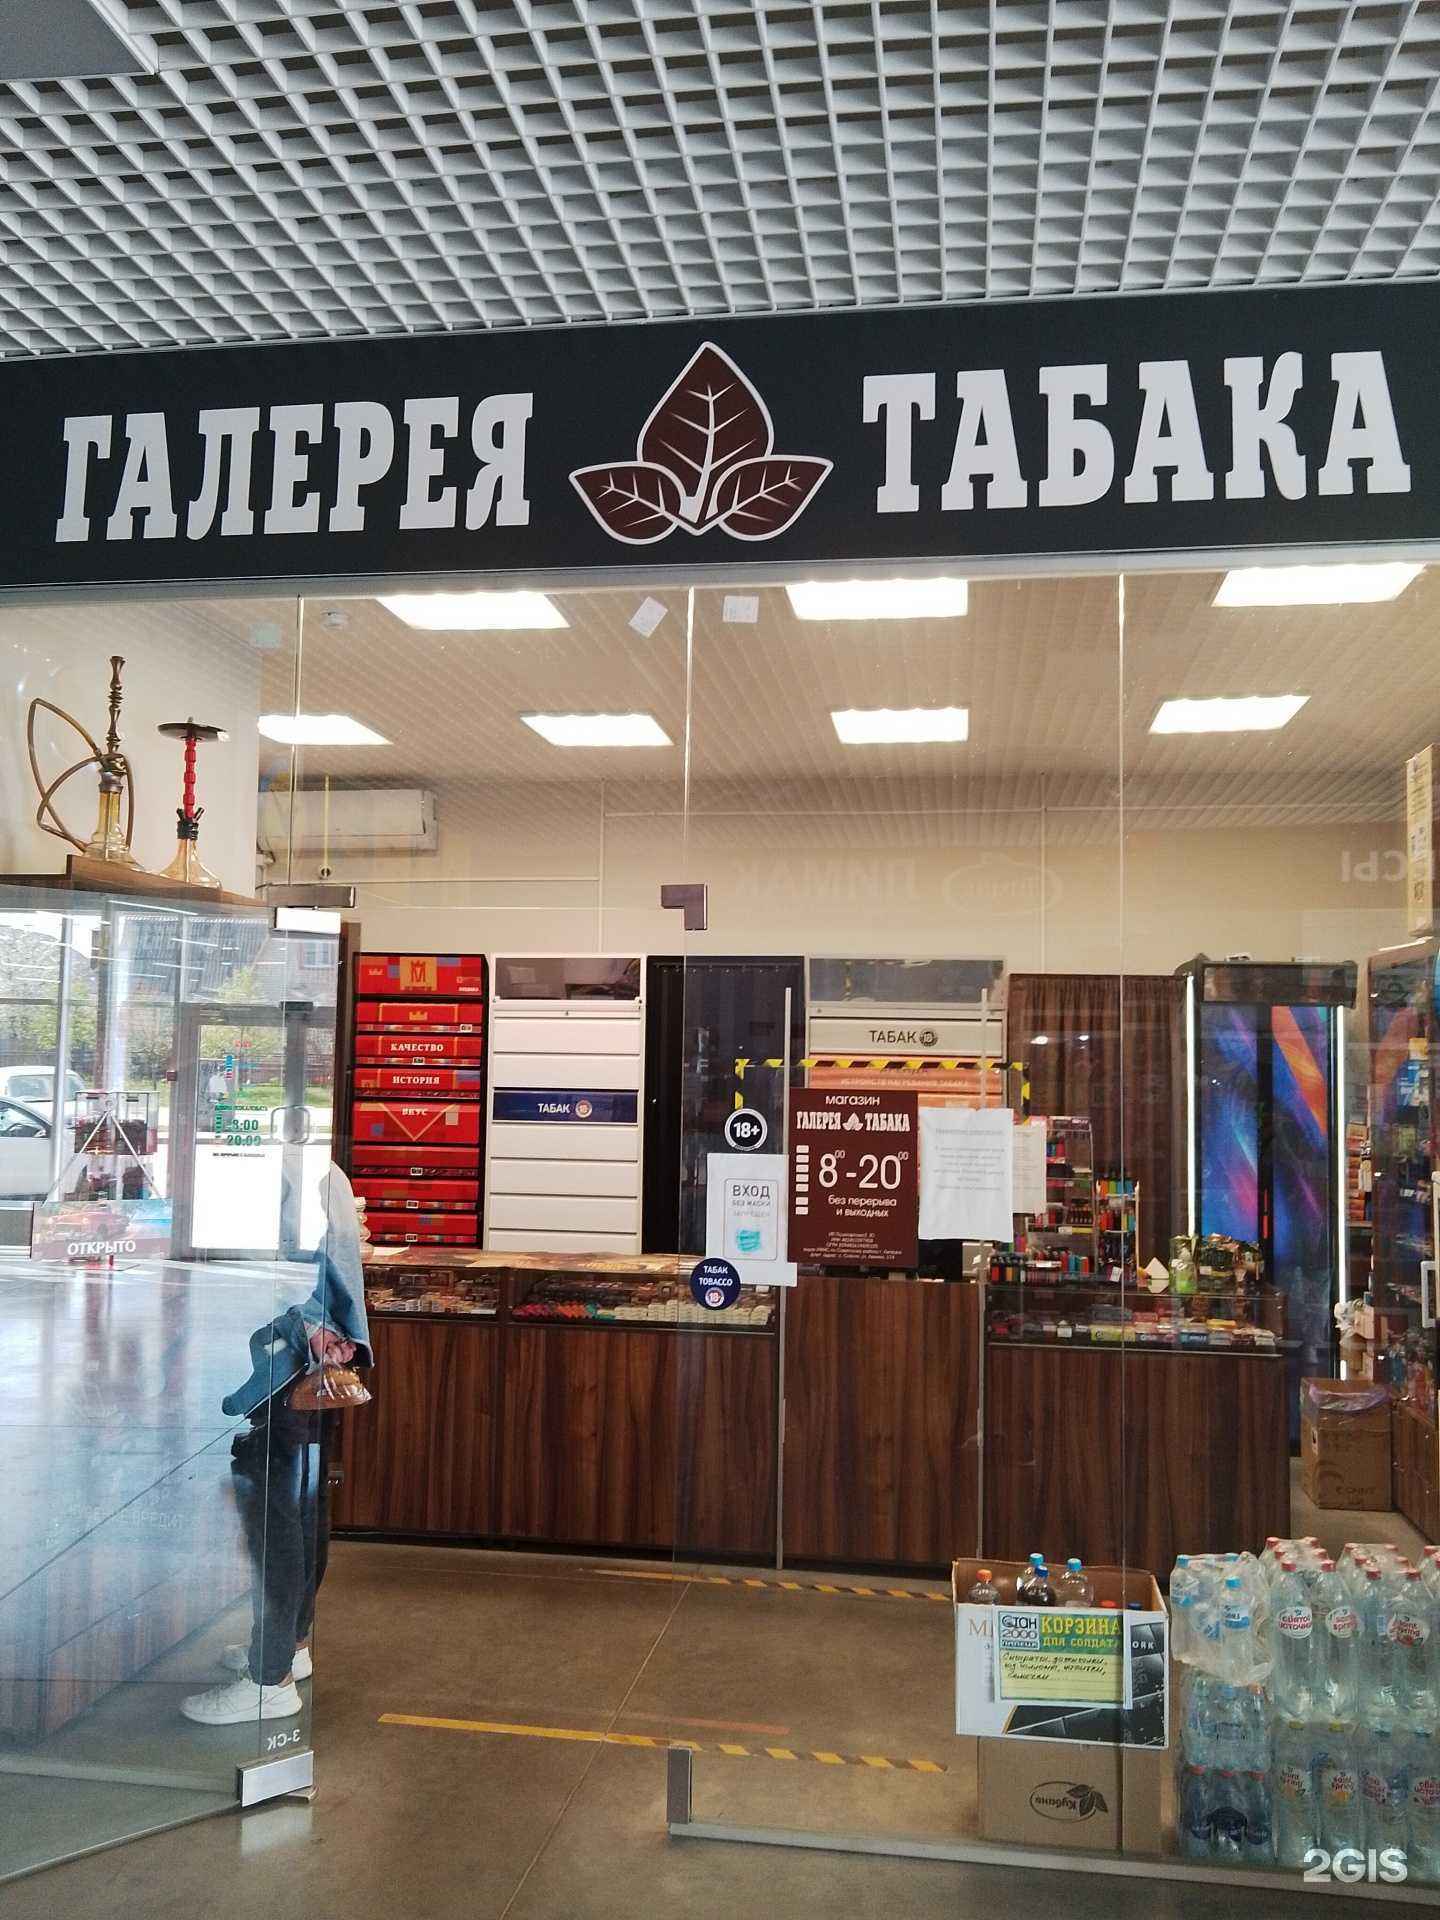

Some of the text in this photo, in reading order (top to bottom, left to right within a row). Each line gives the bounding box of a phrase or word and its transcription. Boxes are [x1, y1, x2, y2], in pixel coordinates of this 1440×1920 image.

[55, 351, 1411, 543] ГАЛЕРЕЯ ТАБАКА
[868, 1030, 917, 1044] ТАБАК
[390, 1043, 444, 1052] КАЧЕСТВО
[392, 1075, 440, 1085] ИСТОРИЯ
[825, 1095, 880, 1106] магазин
[402, 1107, 429, 1116] ВКУС
[537, 1103, 571, 1114] ТАБАК
[796, 1111, 911, 1132] ГАЛЕРЕЯ ТАБАКА
[733, 1121, 760, 1138] 18+
[227, 1134, 261, 1146] 20:00
[732, 1184, 770, 1199] ВХОД
[828, 1194, 897, 1207] без перерыва
[844, 1208, 889, 1218] выходных
[67, 1239, 137, 1255] ОТКРЫТО
[703, 1265, 728, 1274] ТАБАК
[698, 1277, 733, 1287] TOBACCO
[1042, 1615, 1121, 1635] КОРЗИНА
